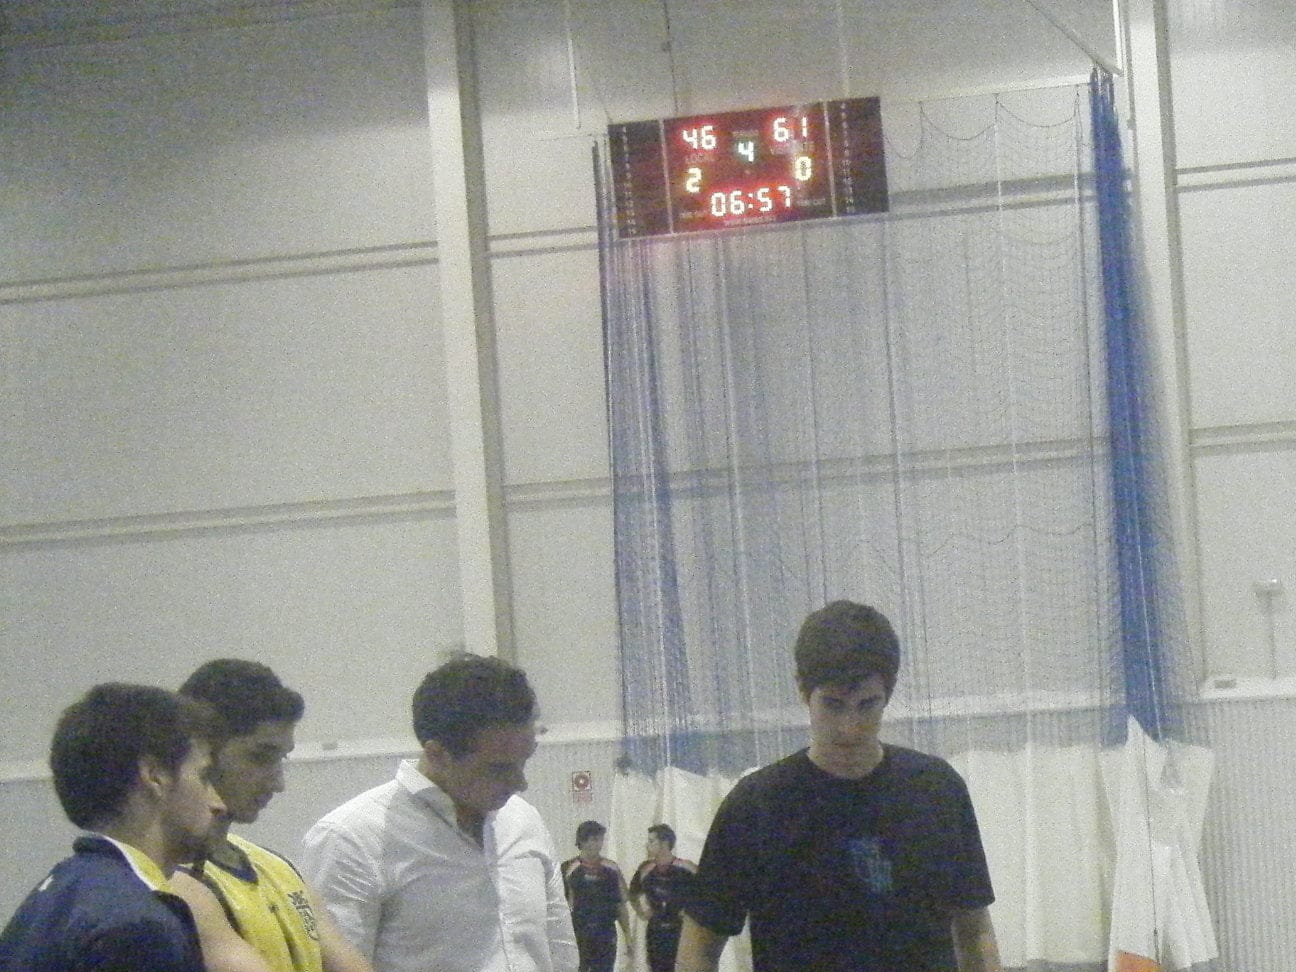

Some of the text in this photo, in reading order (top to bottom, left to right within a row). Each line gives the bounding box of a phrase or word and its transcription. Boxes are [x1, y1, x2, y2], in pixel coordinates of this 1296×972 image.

[683, 125, 717, 150] 46
[773, 117, 808, 142] 61
[738, 141, 754, 162] 4
[685, 167, 702, 193] 2
[795, 156, 812, 181] 0
[710, 185, 791, 217] 06:57
